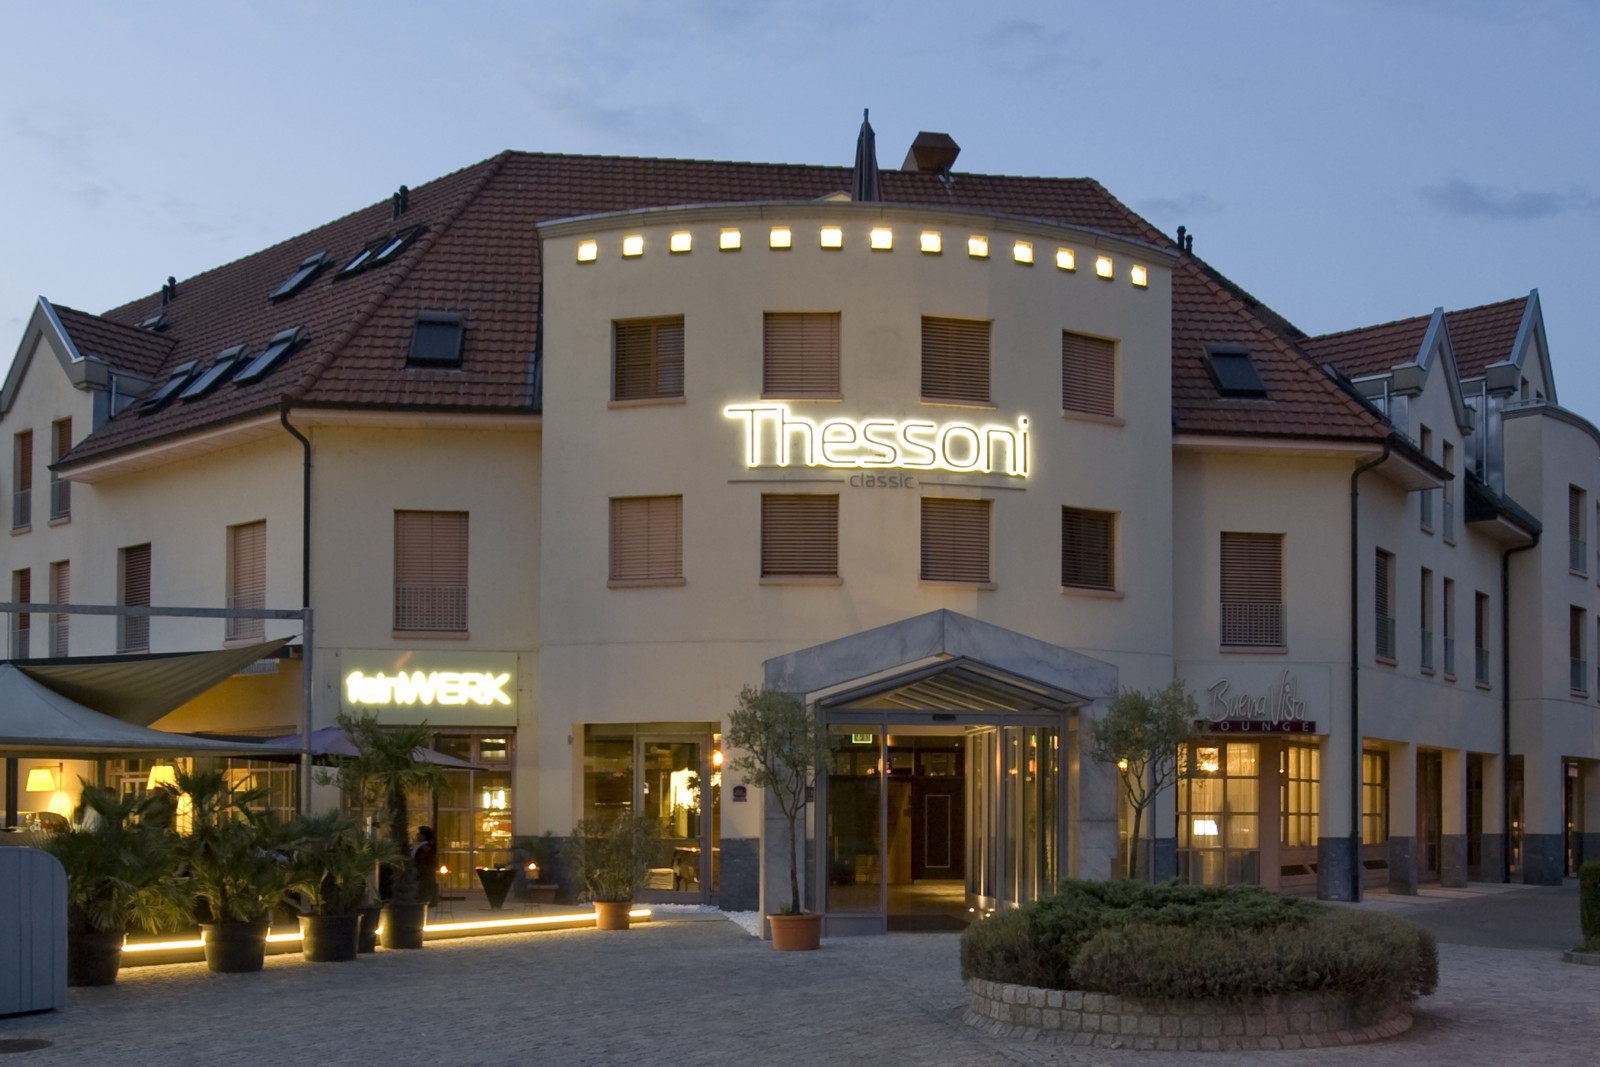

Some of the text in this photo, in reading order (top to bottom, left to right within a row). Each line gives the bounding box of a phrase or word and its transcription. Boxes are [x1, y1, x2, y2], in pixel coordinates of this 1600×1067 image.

[725, 405, 1030, 476] Thessoni
[849, 471, 915, 489] classic
[1207, 668, 1307, 726] Buena Vista
[1201, 720, 1310, 732] OUNGE
